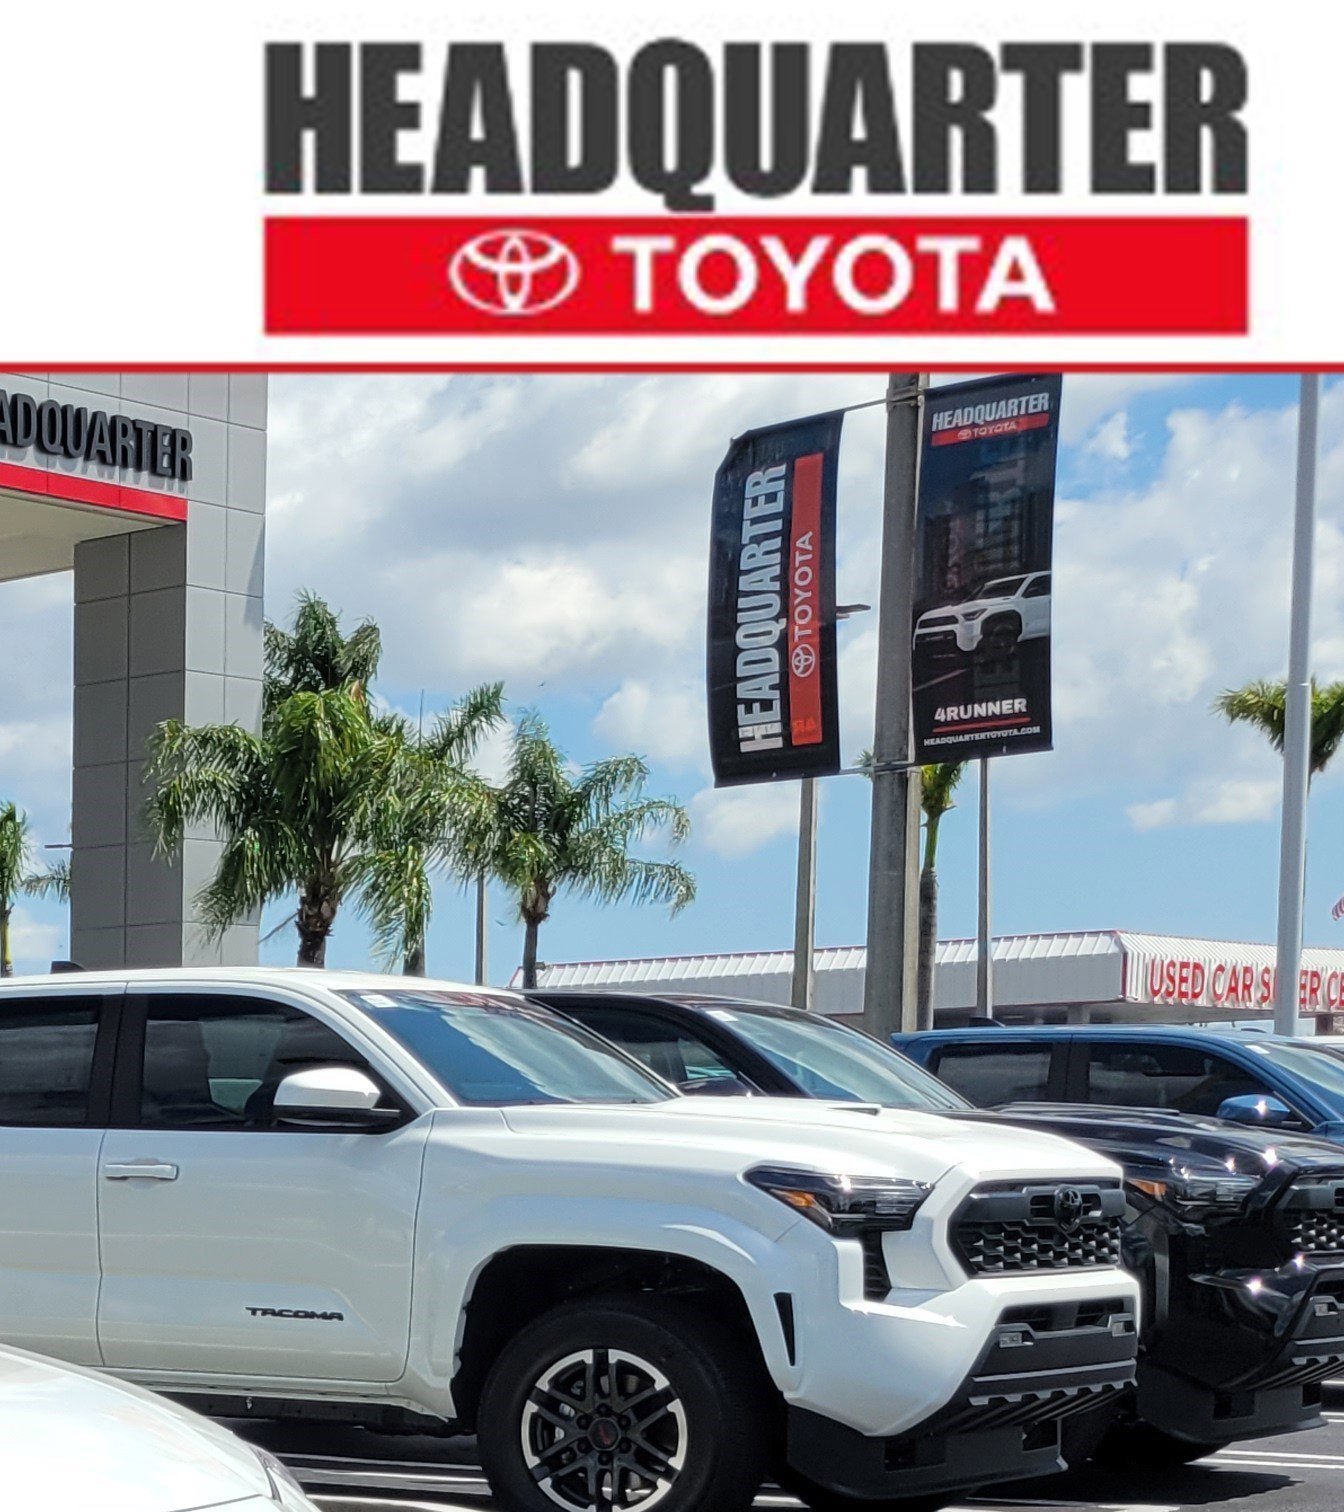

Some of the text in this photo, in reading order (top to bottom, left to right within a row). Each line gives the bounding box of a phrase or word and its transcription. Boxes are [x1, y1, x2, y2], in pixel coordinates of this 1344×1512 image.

[932, 393, 1049, 431] HEADQUARTER
[973, 421, 1016, 437] TOYOTA
[793, 531, 813, 641] TOYOTA
[735, 462, 787, 753] HEADQUARTER
[934, 698, 1027, 722] 4RUNNER
[924, 726, 1040, 746] HEADQUARTERTOYOTA.COM
[1150, 959, 1205, 999] USED
[1212, 964, 1254, 1001] CAR
[1260, 966, 1321, 1005] SER
[245, 1307, 344, 1321] TACOMA
